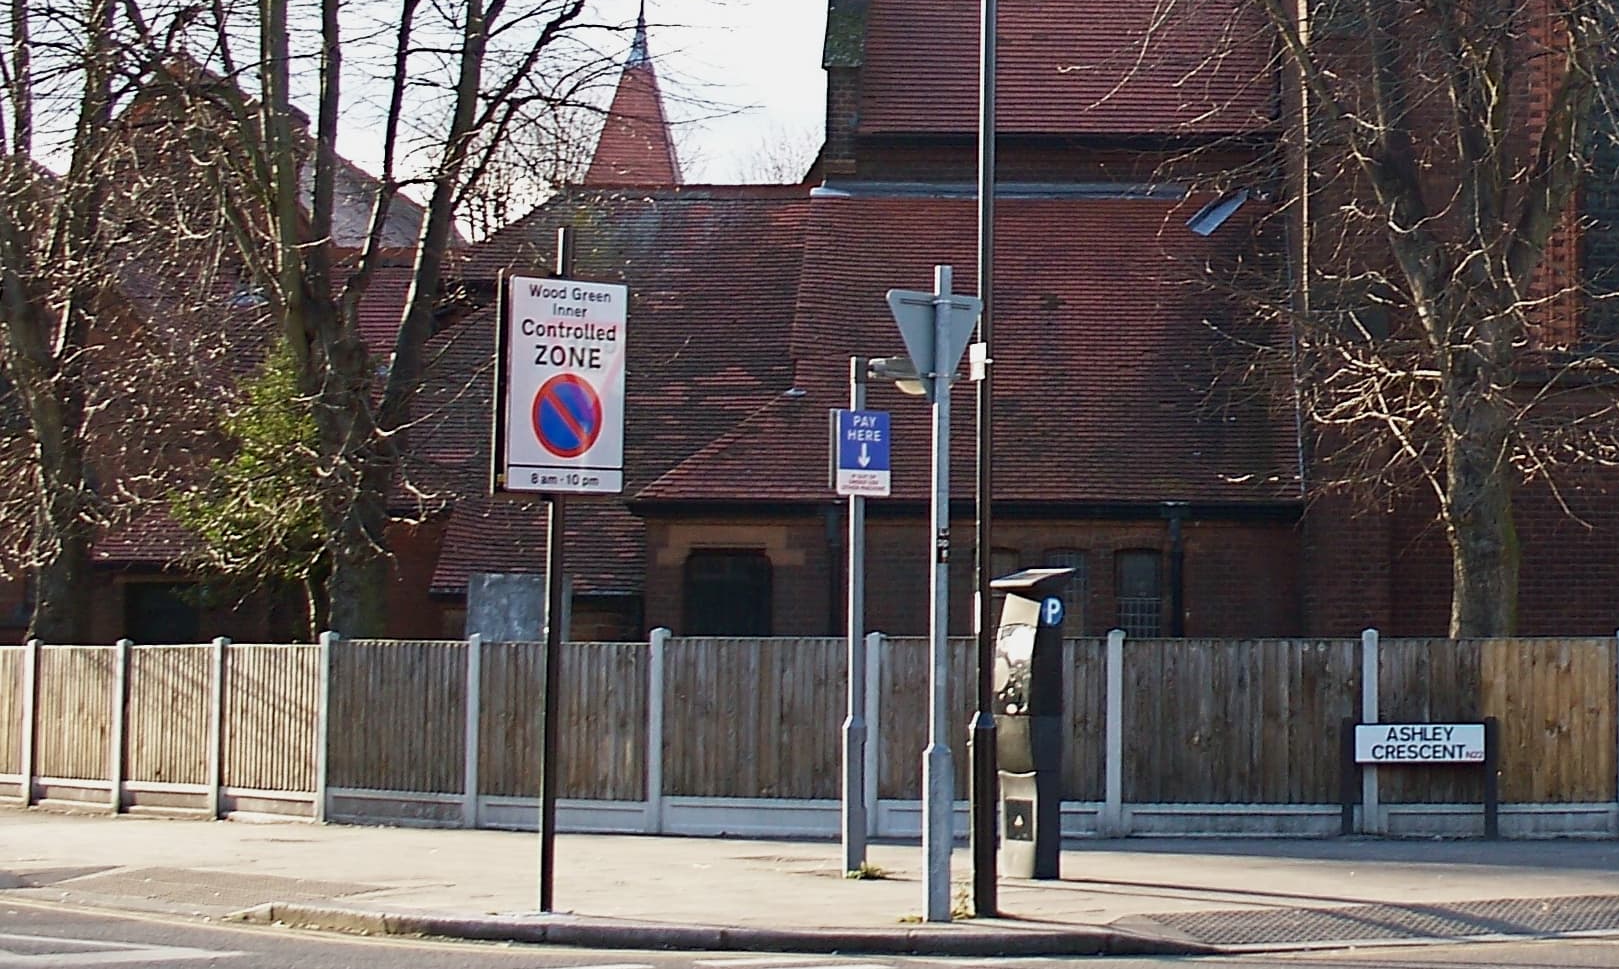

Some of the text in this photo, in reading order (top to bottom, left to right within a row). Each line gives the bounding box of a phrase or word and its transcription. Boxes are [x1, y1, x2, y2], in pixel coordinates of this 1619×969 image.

[529, 283, 611, 303] Wood Green
[553, 302, 588, 318] Inner
[521, 318, 617, 342] Controlled
[534, 344, 602, 369] ZONE
[853, 415, 877, 428] PAY
[847, 429, 883, 442] HERE
[1047, 597, 1061, 624] P
[1386, 726, 1454, 742] ASHLEY
[1371, 744, 1466, 760] CRESCENT
